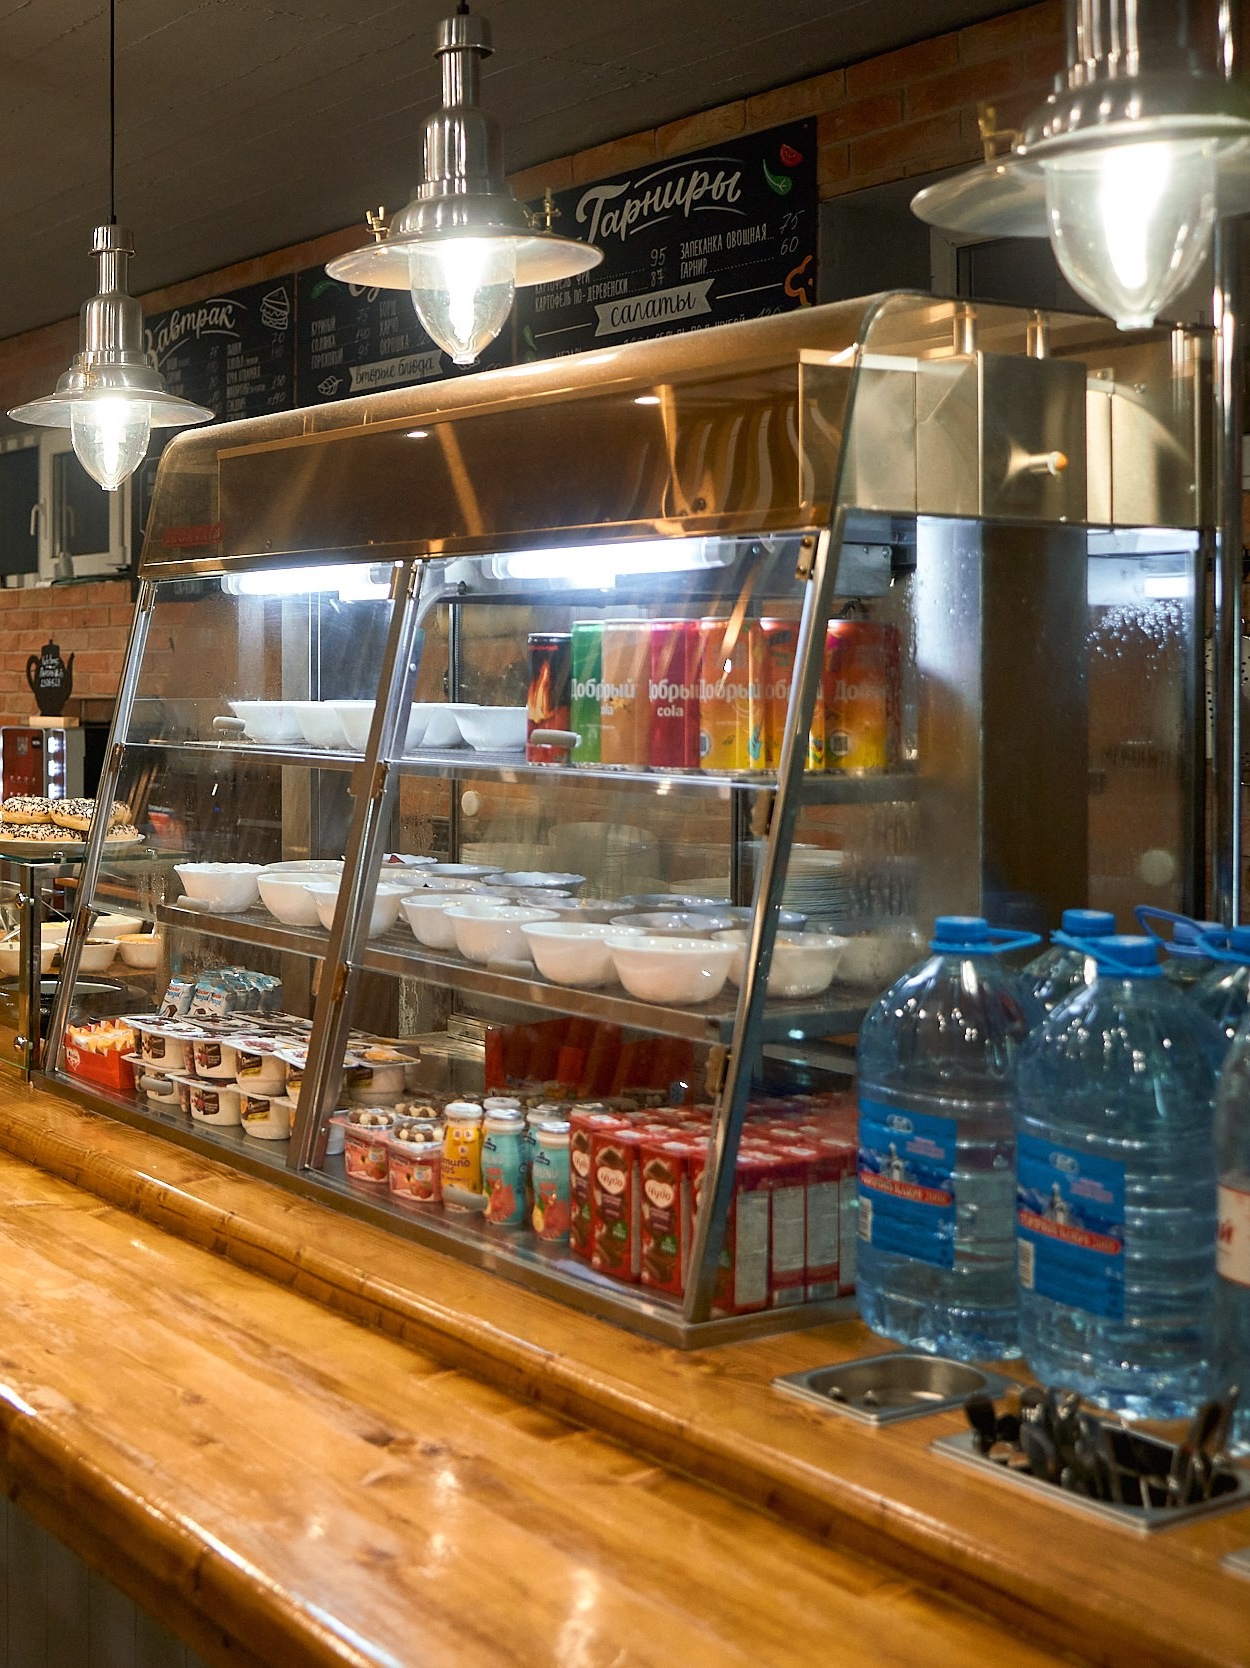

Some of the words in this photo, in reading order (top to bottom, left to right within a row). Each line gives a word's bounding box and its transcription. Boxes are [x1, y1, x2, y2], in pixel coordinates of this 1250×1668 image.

[575, 170, 742, 244] Гарниры
[679, 236, 723, 260] ЗАПЕКАНКА
[726, 223, 768, 250] ОВОЩНАЯ
[779, 210, 804, 234] 75
[650, 246, 666, 267] 95
[679, 257, 708, 280] ГАРНИР
[780, 236, 799, 256] 60
[534, 290, 572, 313] КАРТОФЕЛЬ
[650, 269, 664, 288] 87
[610, 291, 696, 328] салаты
[144, 304, 236, 372] Завтрак
[355, 365, 396, 386] вторые
[399, 356, 434, 380] блюда
[657, 704, 684, 717] cola
[600, 1174, 624, 1187] Чудо
[647, 1185, 672, 1201] Чудо
